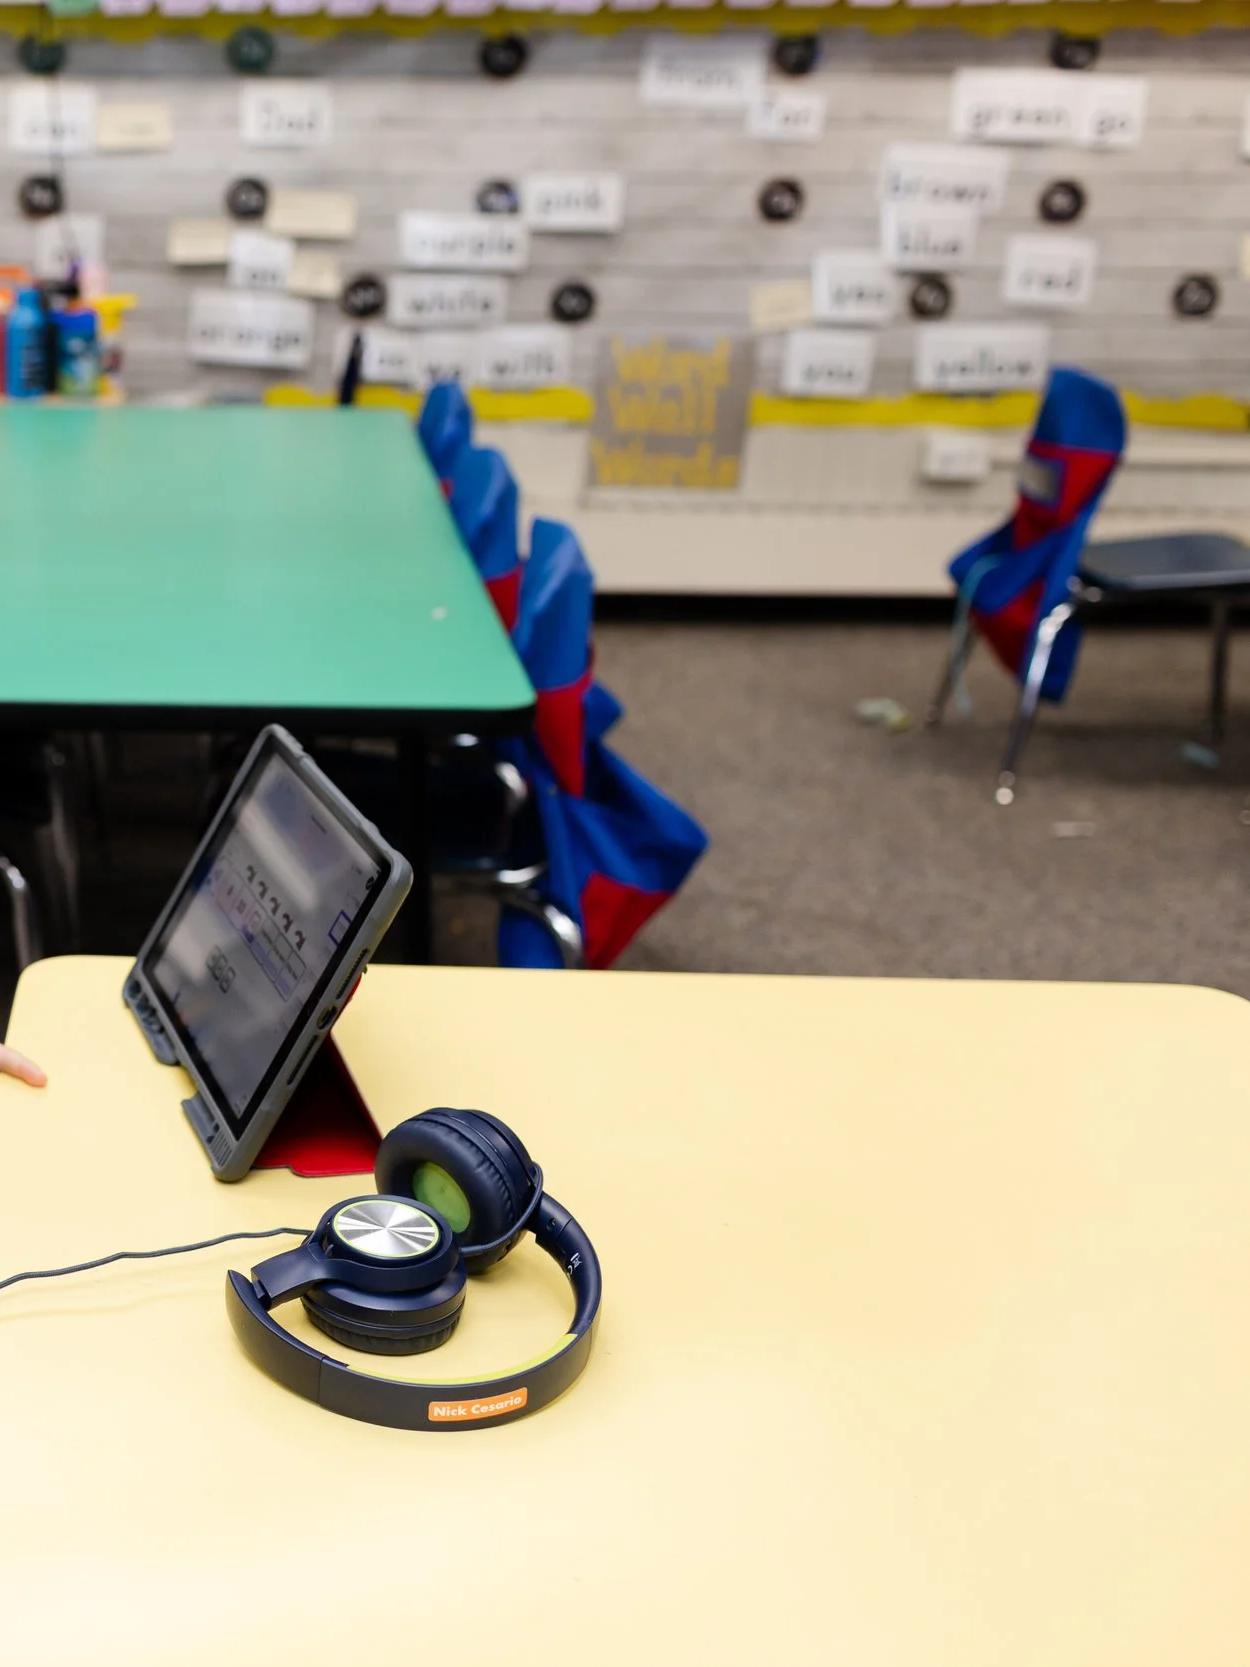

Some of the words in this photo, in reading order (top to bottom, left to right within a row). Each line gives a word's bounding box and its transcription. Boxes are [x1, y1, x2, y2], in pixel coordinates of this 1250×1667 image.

[968, 103, 1069, 139] green
[1092, 110, 1132, 139] go
[888, 167, 993, 204] brown
[898, 226, 963, 258] blue
[405, 287, 496, 317] white
[933, 347, 1033, 384] yellow
[433, 1405, 468, 1417] Nick
[471, 1396, 522, 1414] Cesario
